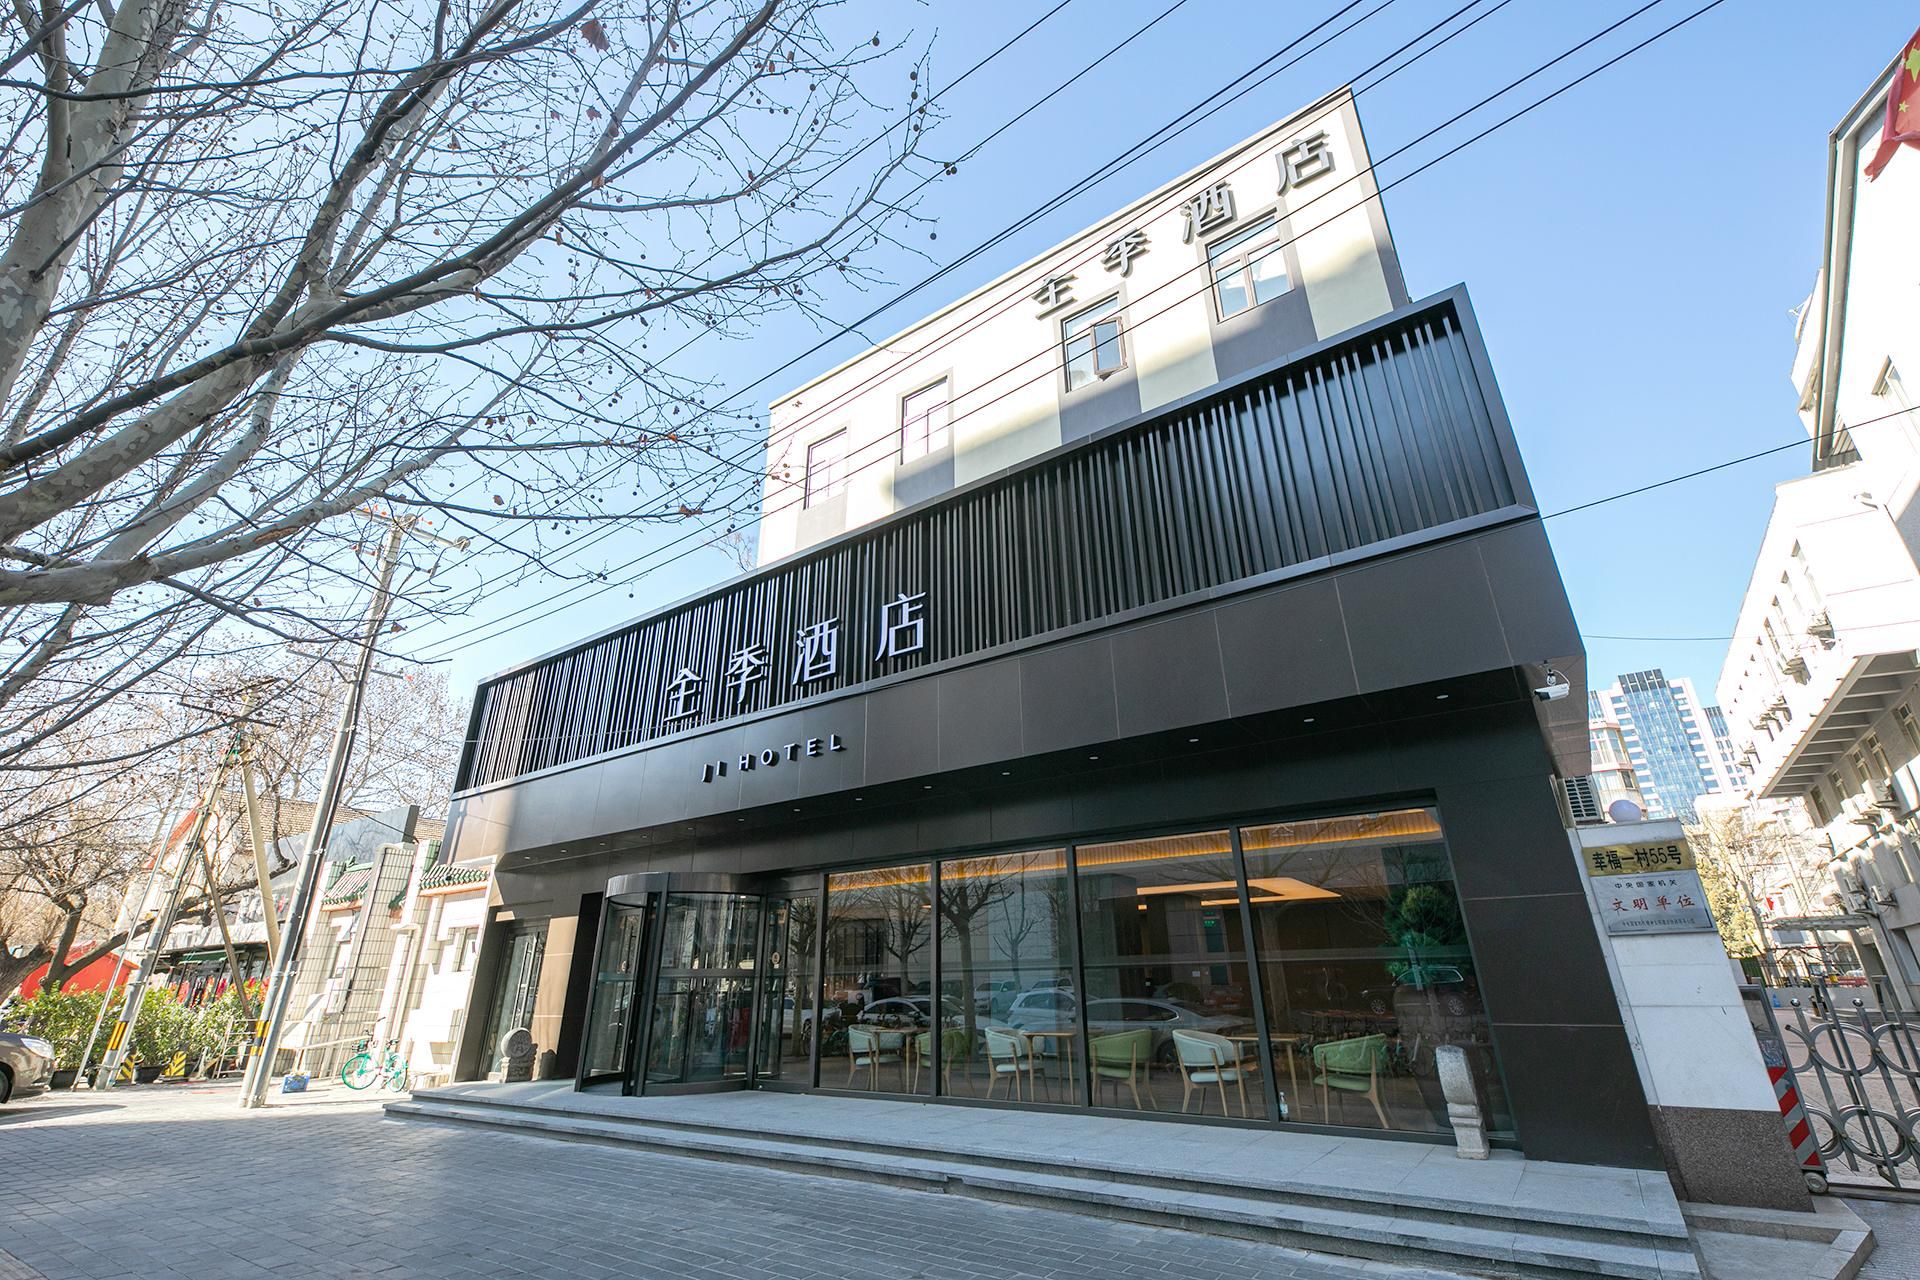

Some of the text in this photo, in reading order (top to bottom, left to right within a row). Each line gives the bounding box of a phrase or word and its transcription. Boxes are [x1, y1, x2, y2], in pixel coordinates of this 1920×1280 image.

[1031, 129, 1336, 320] 全季酒店
[664, 592, 926, 721] 全季酒店
[701, 734, 843, 783] JI HOTEL
[1592, 845, 1682, 871] 幸福一村55号
[1614, 879, 1678, 889] 中央国家机关
[1612, 894, 1696, 912] 文明单位
